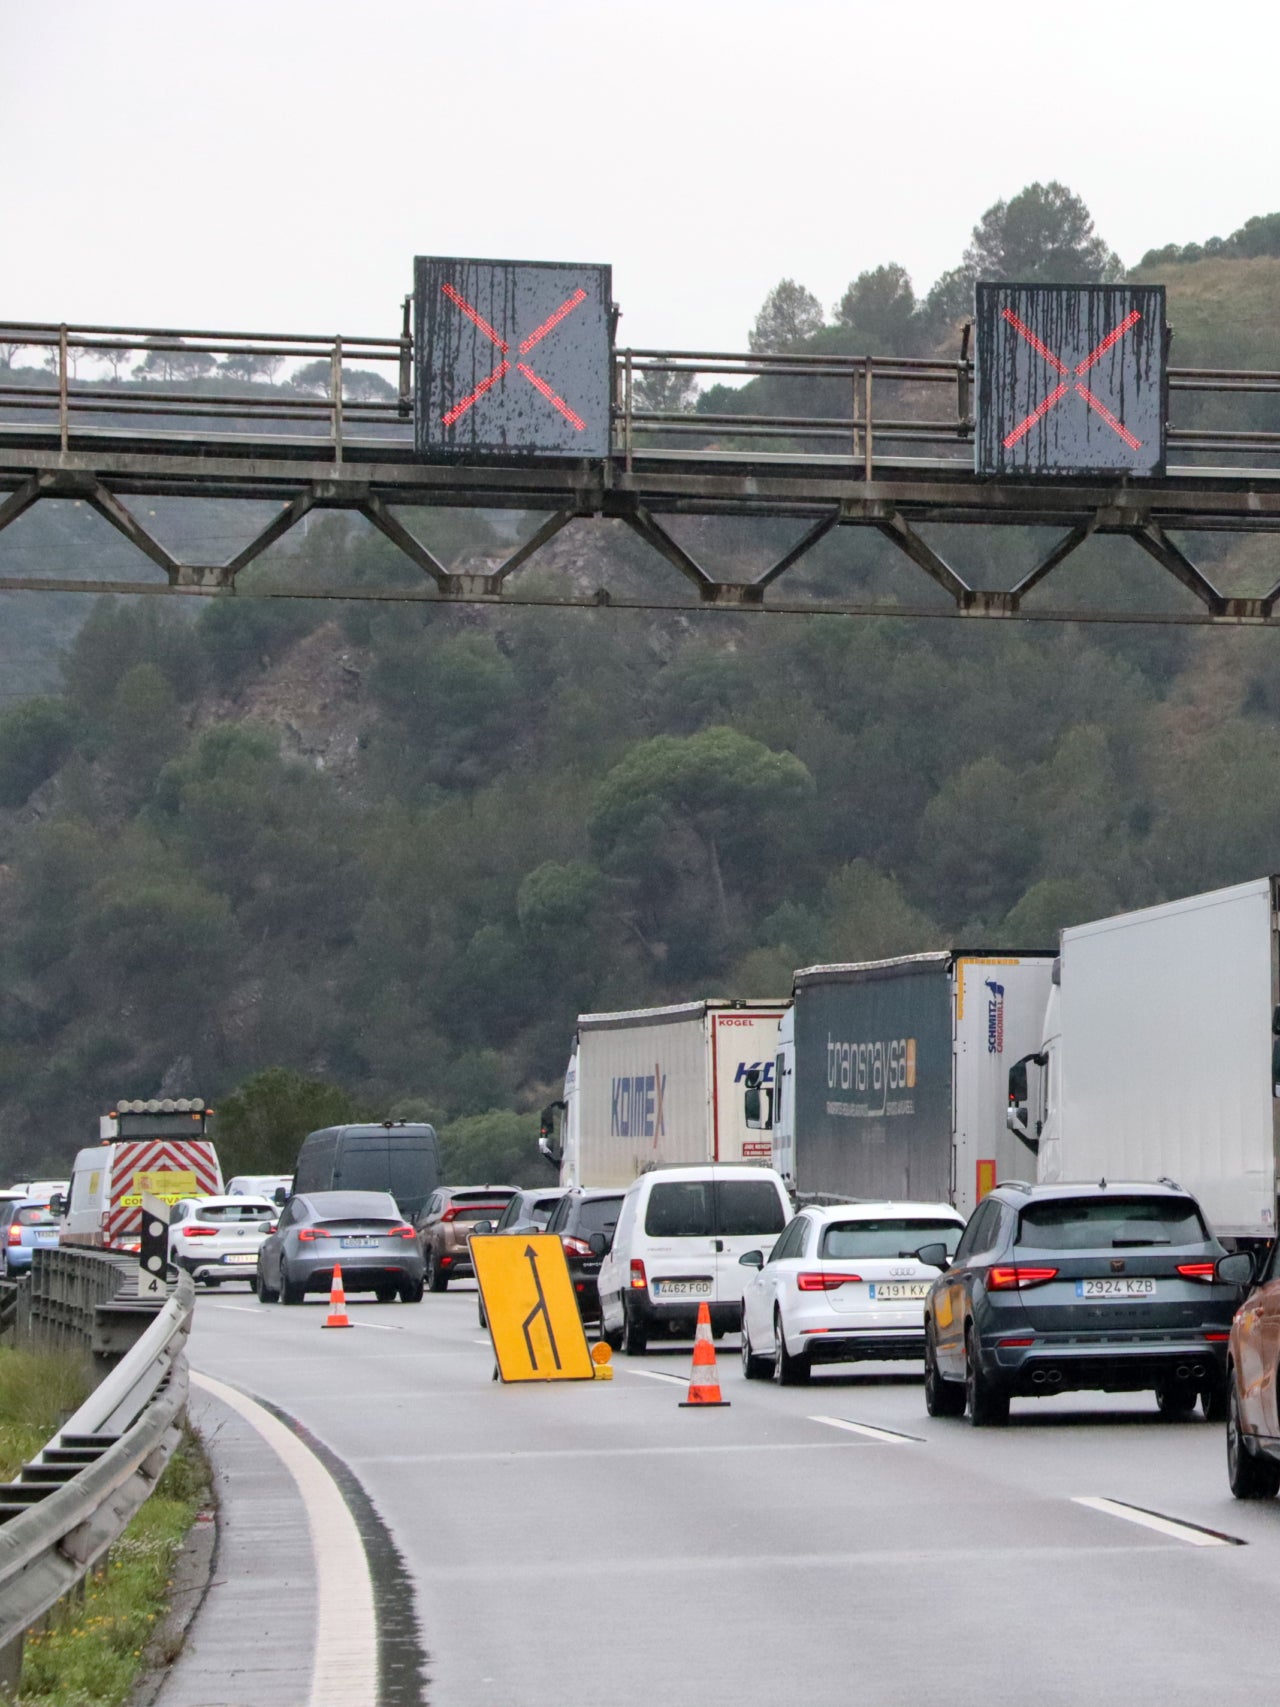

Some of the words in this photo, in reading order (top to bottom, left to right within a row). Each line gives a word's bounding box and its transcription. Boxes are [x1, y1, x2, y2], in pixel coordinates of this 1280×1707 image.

[988, 1000, 997, 1054] SCHMITZ
[827, 1031, 907, 1117] transraysa
[148, 1279, 158, 1293] 4
[661, 1283, 687, 1294] 4462
[689, 1283, 709, 1293] FGD
[877, 1285, 906, 1296] 4191
[910, 1284, 934, 1296] KX
[1086, 1280, 1122, 1294] 2924
[1126, 1280, 1153, 1293] KZB
